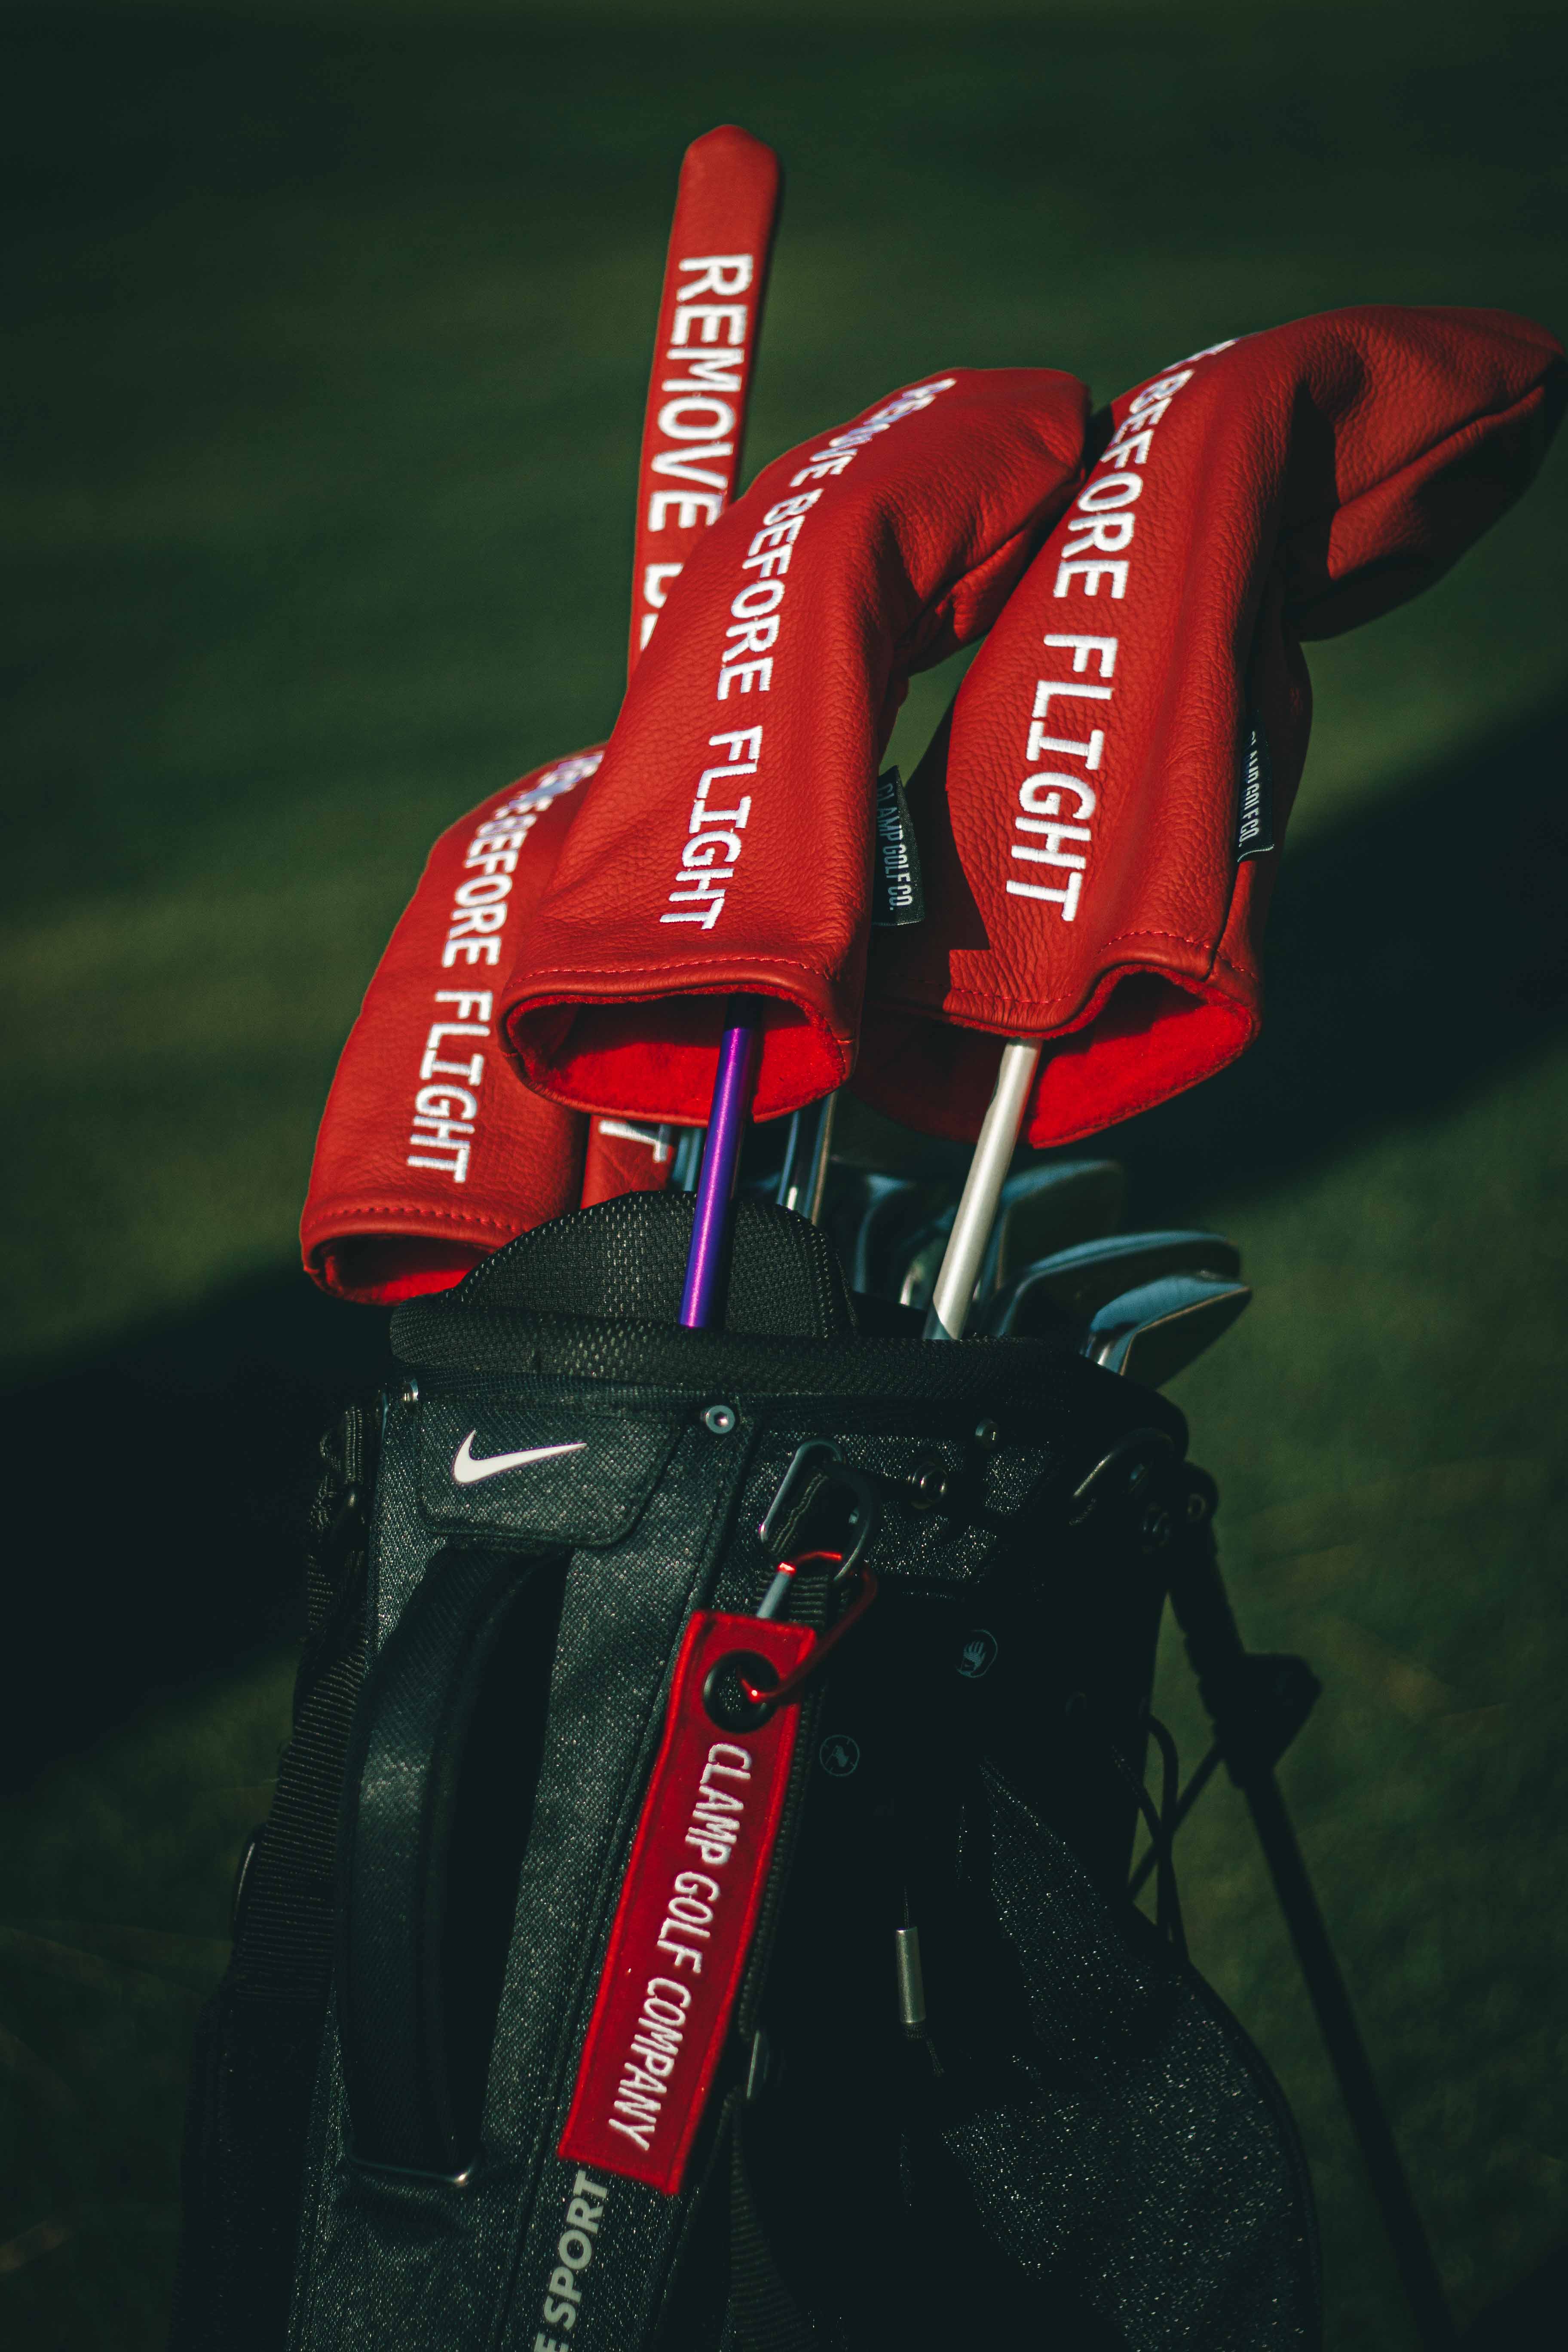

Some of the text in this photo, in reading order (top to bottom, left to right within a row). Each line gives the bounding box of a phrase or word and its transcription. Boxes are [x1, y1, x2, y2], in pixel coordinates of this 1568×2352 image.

[648, 253, 753, 532] REMOVE
[717, 488, 824, 701] BEFORE
[1006, 369, 1195, 922] BEFORE FLIGHT
[659, 725, 763, 930] FLIGHT
[882, 844, 911, 882] GOLF
[888, 884, 913, 911] CO.
[407, 814, 537, 1183] BEFORE FLIGHT
[608, 1742, 753, 2151] CLAMP GOLF COMPANY
[544, 2169, 608, 2331] SPORT
